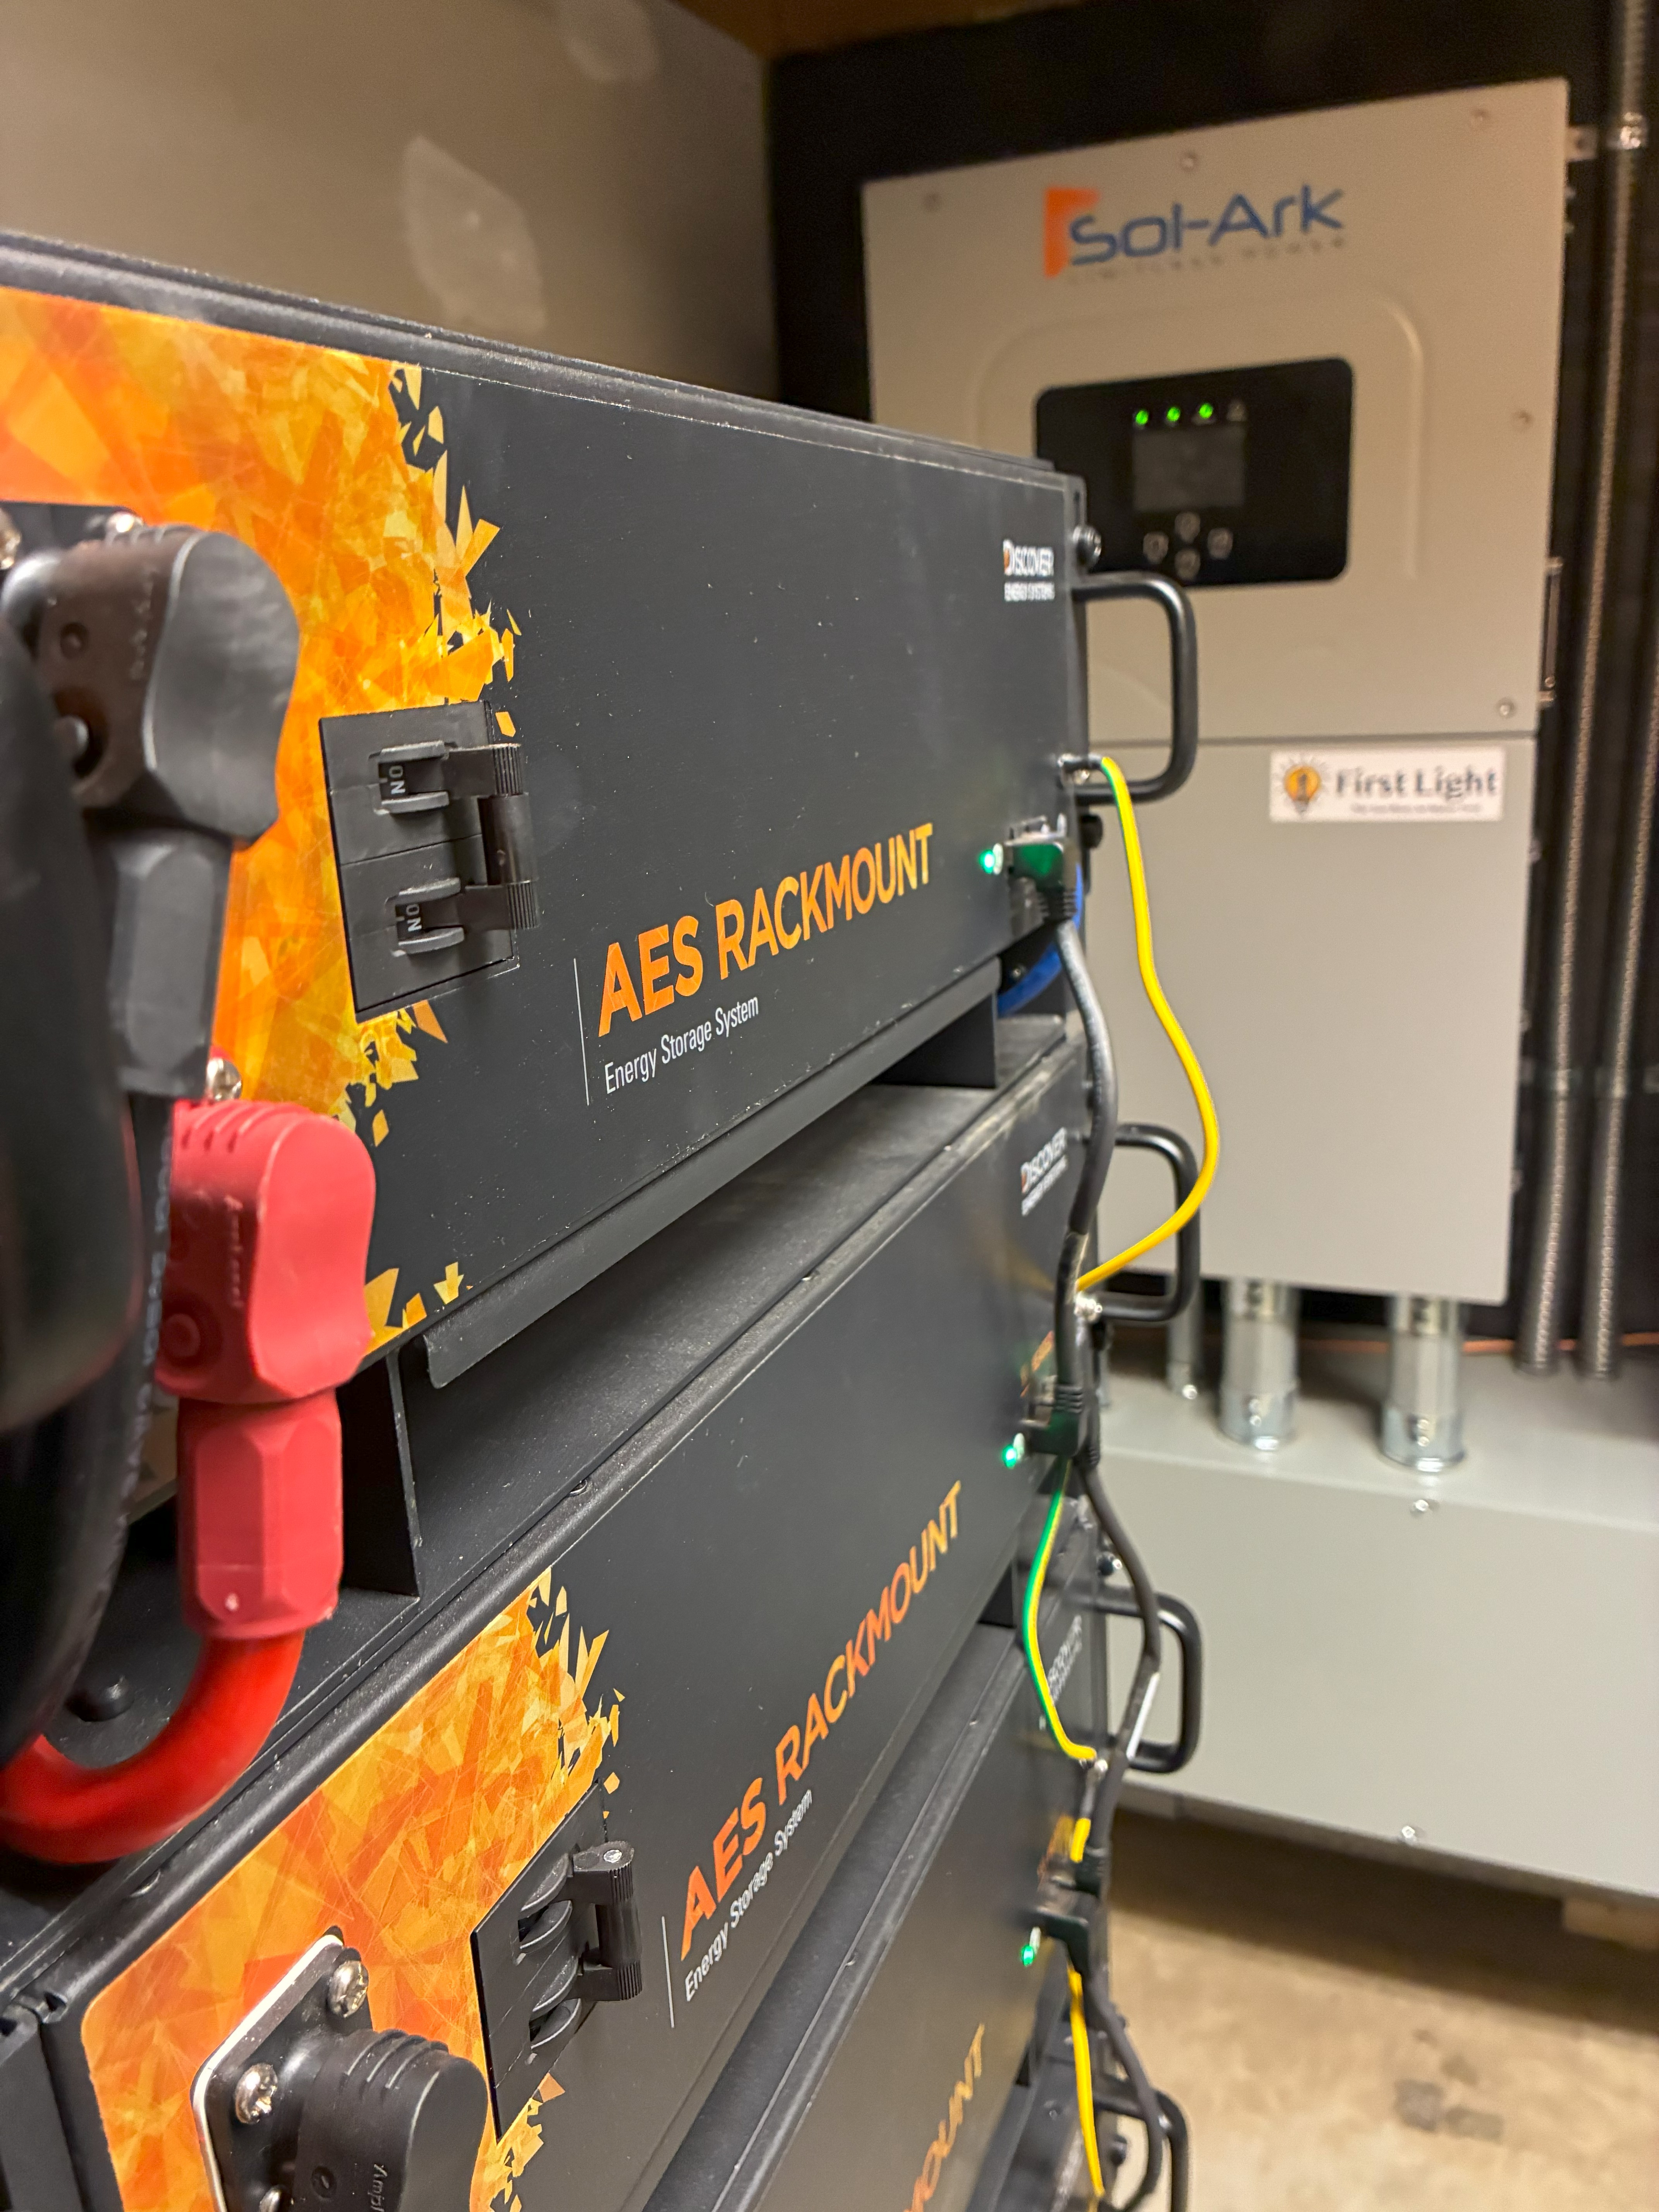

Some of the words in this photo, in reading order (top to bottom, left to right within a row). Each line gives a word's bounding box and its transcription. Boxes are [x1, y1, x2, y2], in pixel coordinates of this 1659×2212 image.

[1069, 185, 1344, 266] Sol-Ark
[388, 765, 405, 795] ON
[1336, 766, 1407, 796] First
[1415, 764, 1497, 802] Light
[405, 903, 422, 932] ON
[598, 915, 704, 1037] AES
[715, 822, 933, 980] RACKMOUNT
[605, 1048, 657, 1094] Energy
[661, 1020, 712, 1064] Storage
[715, 996, 759, 1038] System
[681, 1777, 766, 1962] AES
[775, 1480, 961, 1806] RACKMOUNT
[685, 1921, 728, 2002] Energy
[730, 1851, 773, 1929] Storage
[775, 1789, 812, 1856] System
